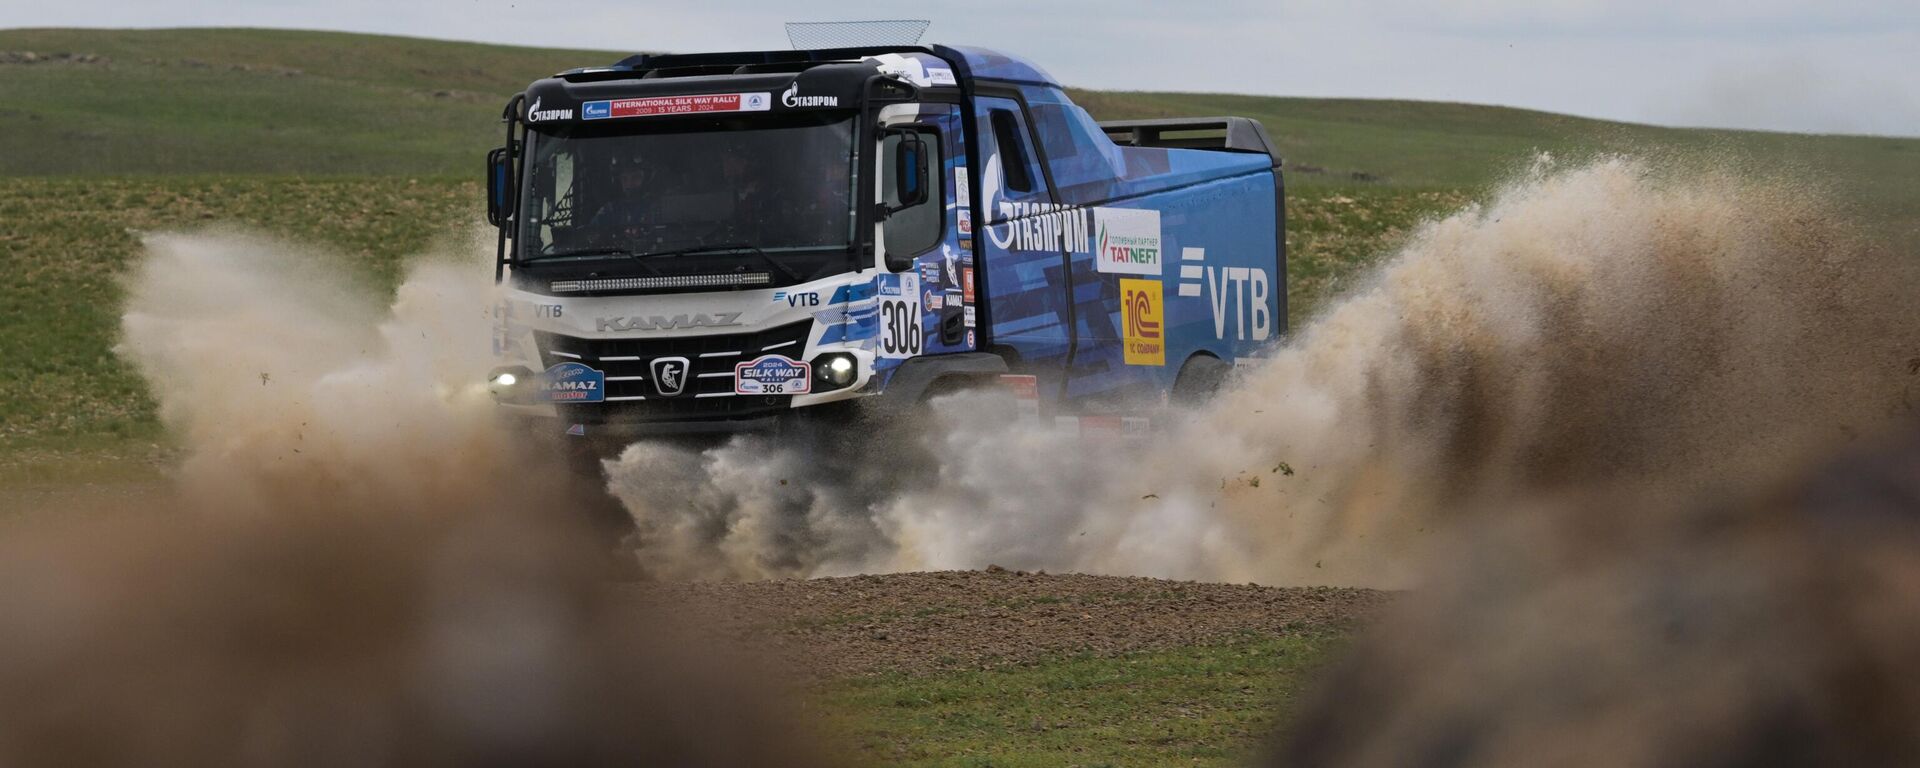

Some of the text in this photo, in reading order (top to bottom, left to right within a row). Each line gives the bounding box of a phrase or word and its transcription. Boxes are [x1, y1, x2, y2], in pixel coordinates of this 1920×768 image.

[613, 95, 738, 109] INTERNATIONAL SILK WAY RALLY
[667, 105, 692, 113] YEARS
[1110, 246, 1158, 264] TATNEFT
[788, 292, 820, 307] VTB
[1207, 266, 1271, 341] VTB
[534, 304, 562, 318] VTB
[597, 312, 743, 332] KAMAZ
[882, 300, 919, 354] 306
[1137, 343, 1160, 355] COMPANY
[743, 368, 802, 378] SILK WAY
[762, 384, 783, 393] 306
